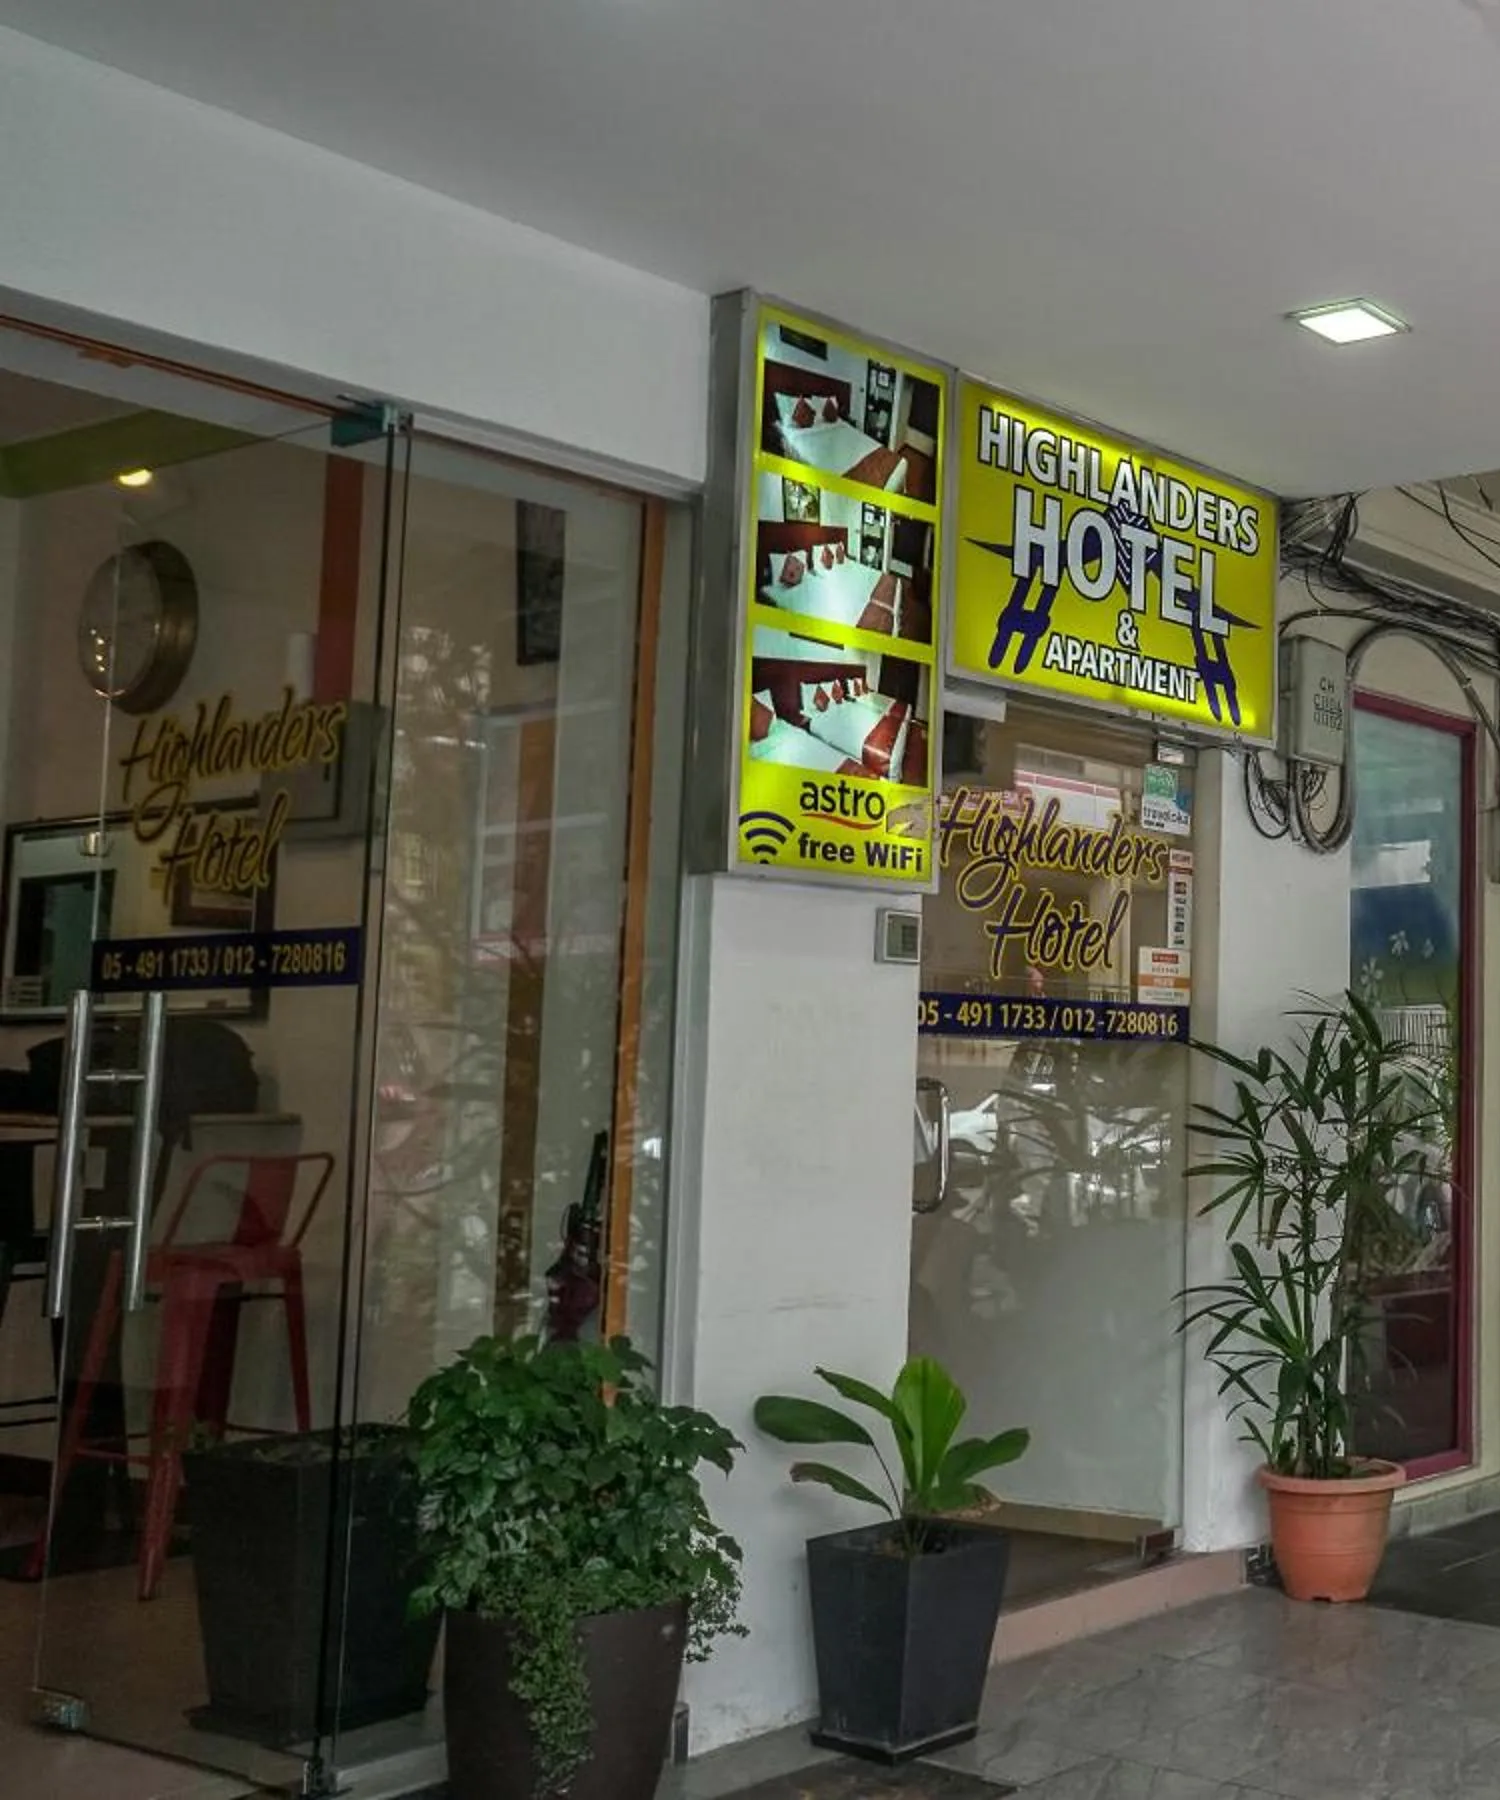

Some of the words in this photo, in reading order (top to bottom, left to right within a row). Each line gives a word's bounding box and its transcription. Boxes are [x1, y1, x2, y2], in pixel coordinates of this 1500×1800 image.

[978, 406, 1259, 556] HIGHLANDERS
[1012, 484, 1230, 637] HOTEL
[1042, 632, 1200, 703] APARTMENT
[1116, 610, 1139, 651] &
[119, 685, 345, 843] Highlanders
[800, 779, 886, 821] astro
[160, 789, 289, 907] Hotel
[798, 831, 854, 864] free
[864, 839, 923, 873] WiFi
[939, 786, 1169, 910] Highlanders
[136, 951, 163, 977] 491
[171, 949, 210, 977] 1733
[224, 946, 254, 974] 012
[985, 884, 1131, 980] Hotel
[956, 1001, 992, 1027] 491
[1001, 1003, 1045, 1030] 1733
